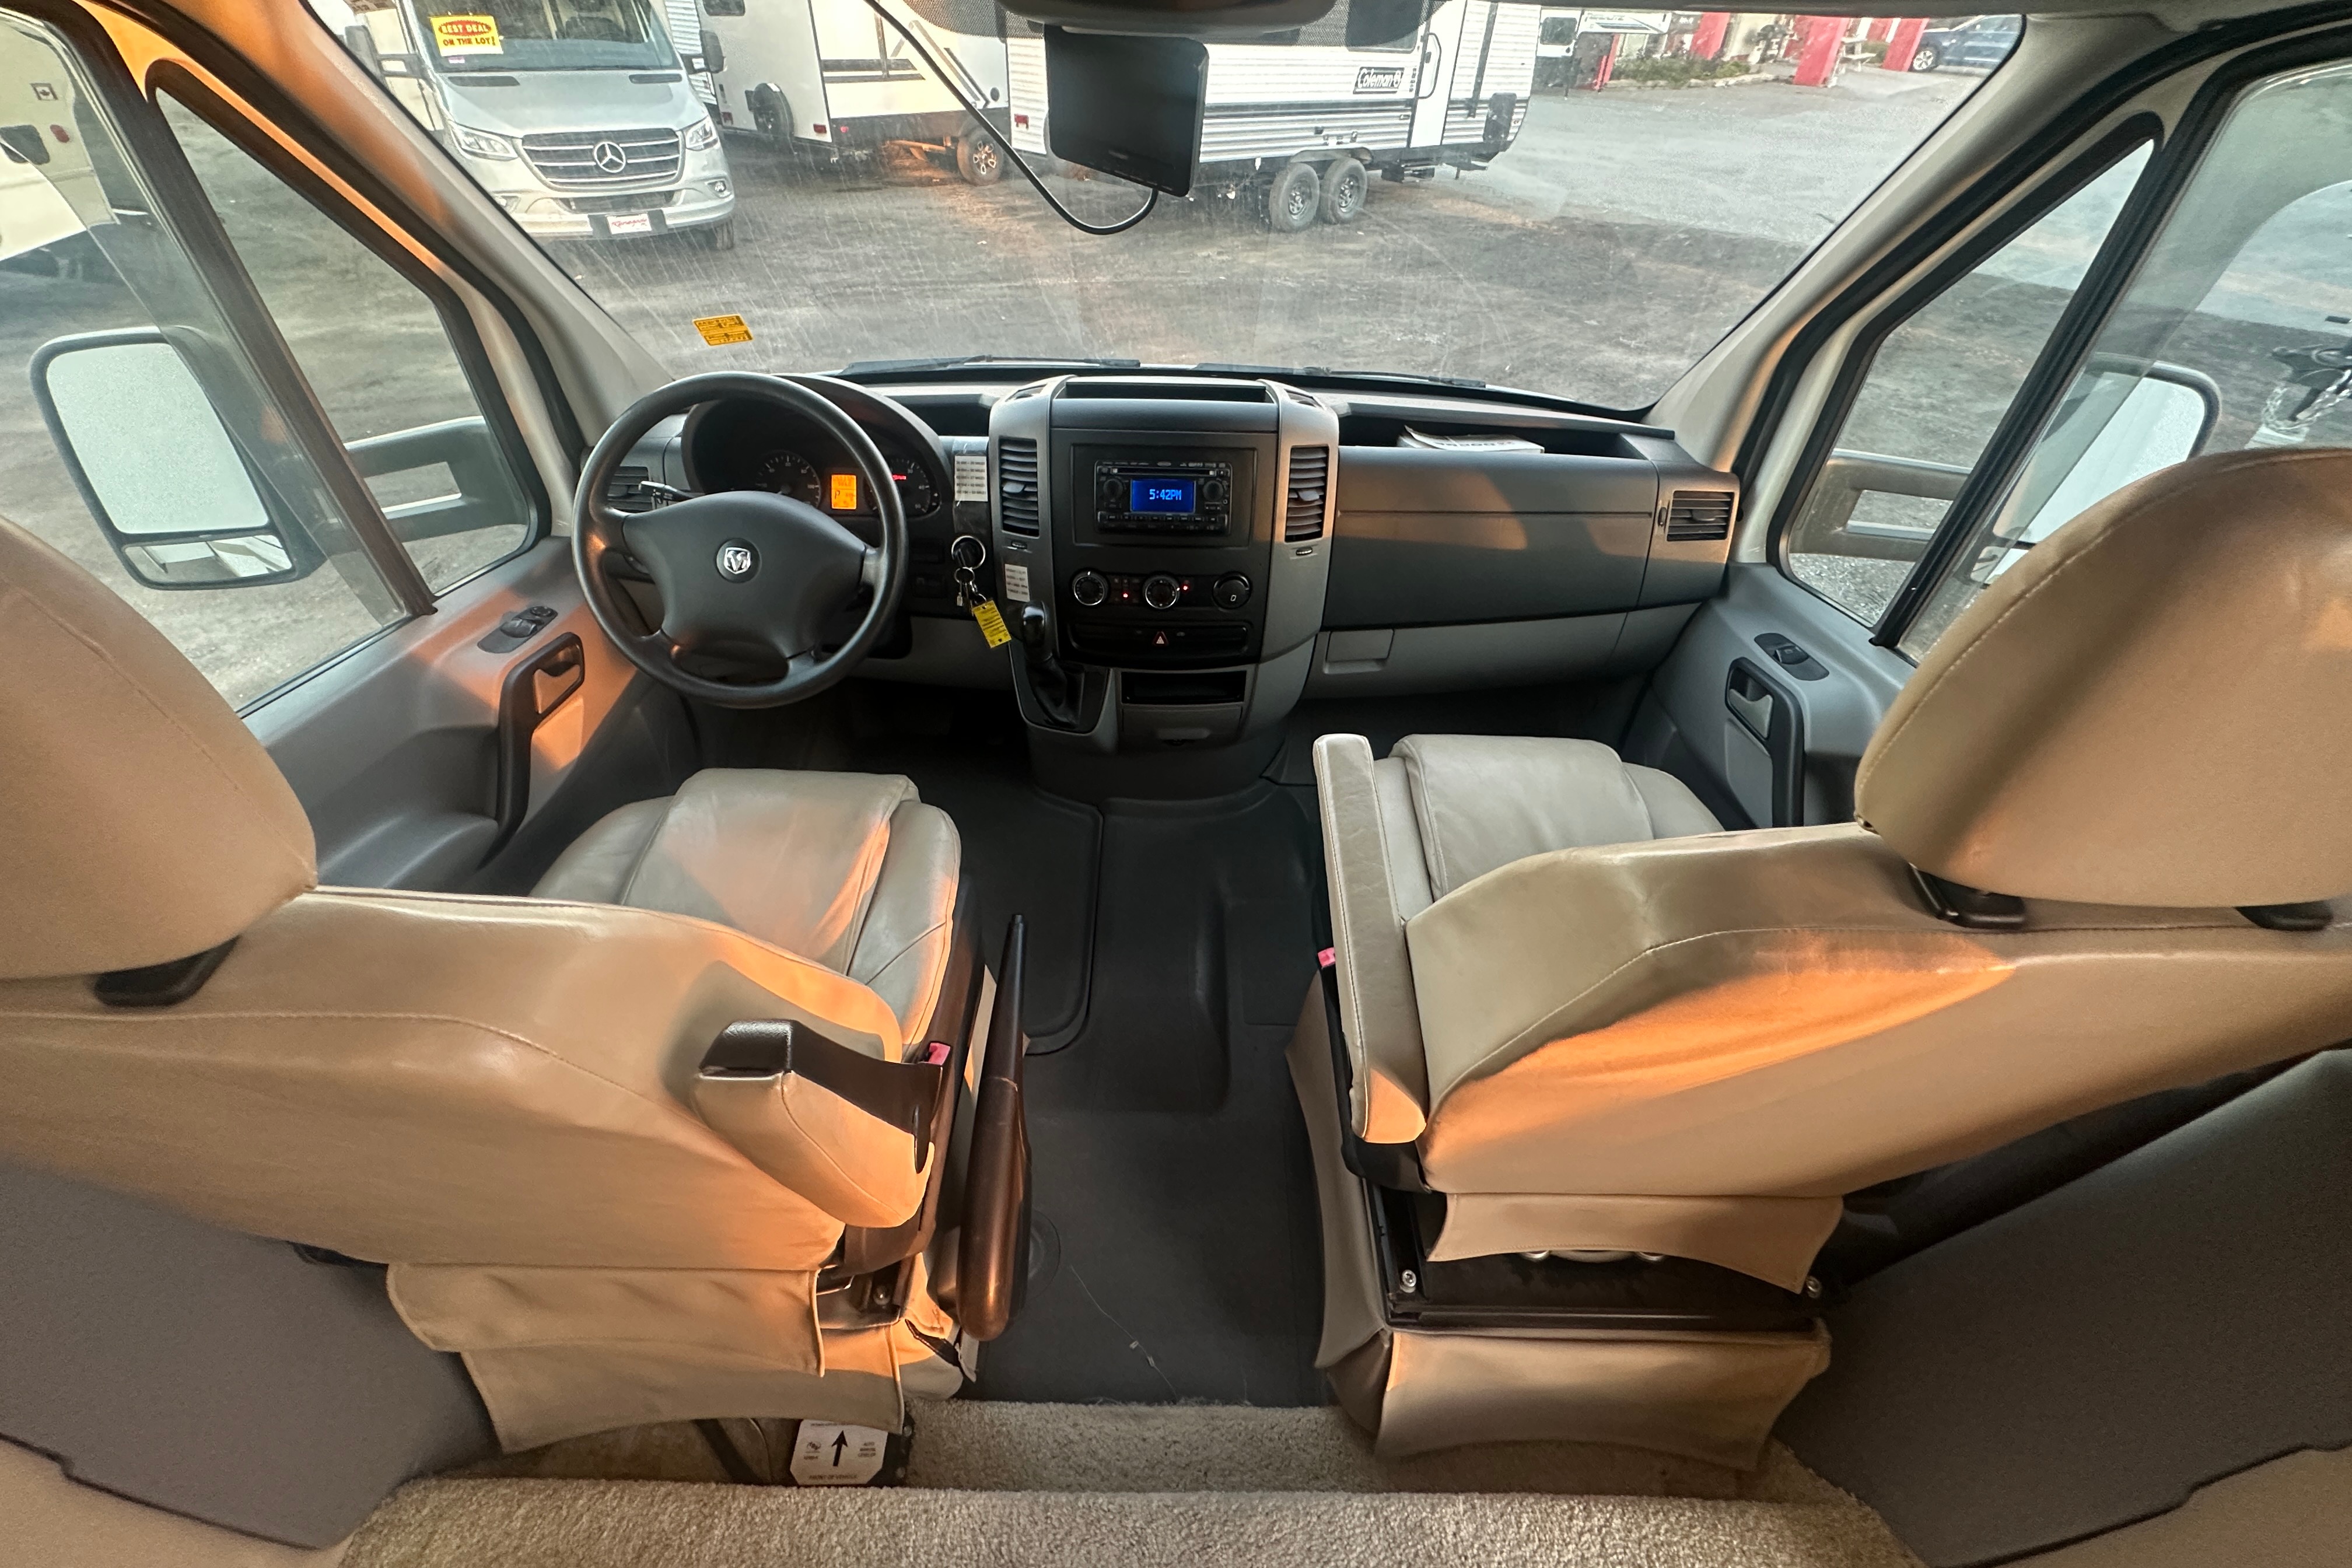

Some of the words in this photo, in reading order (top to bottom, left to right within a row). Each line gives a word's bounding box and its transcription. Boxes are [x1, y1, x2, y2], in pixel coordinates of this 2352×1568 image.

[441, 24, 463, 33] BEST
[466, 24, 489, 33] DEAL
[1357, 68, 1394, 88] Coleman
[1149, 489, 1182, 501] 5:42PM
